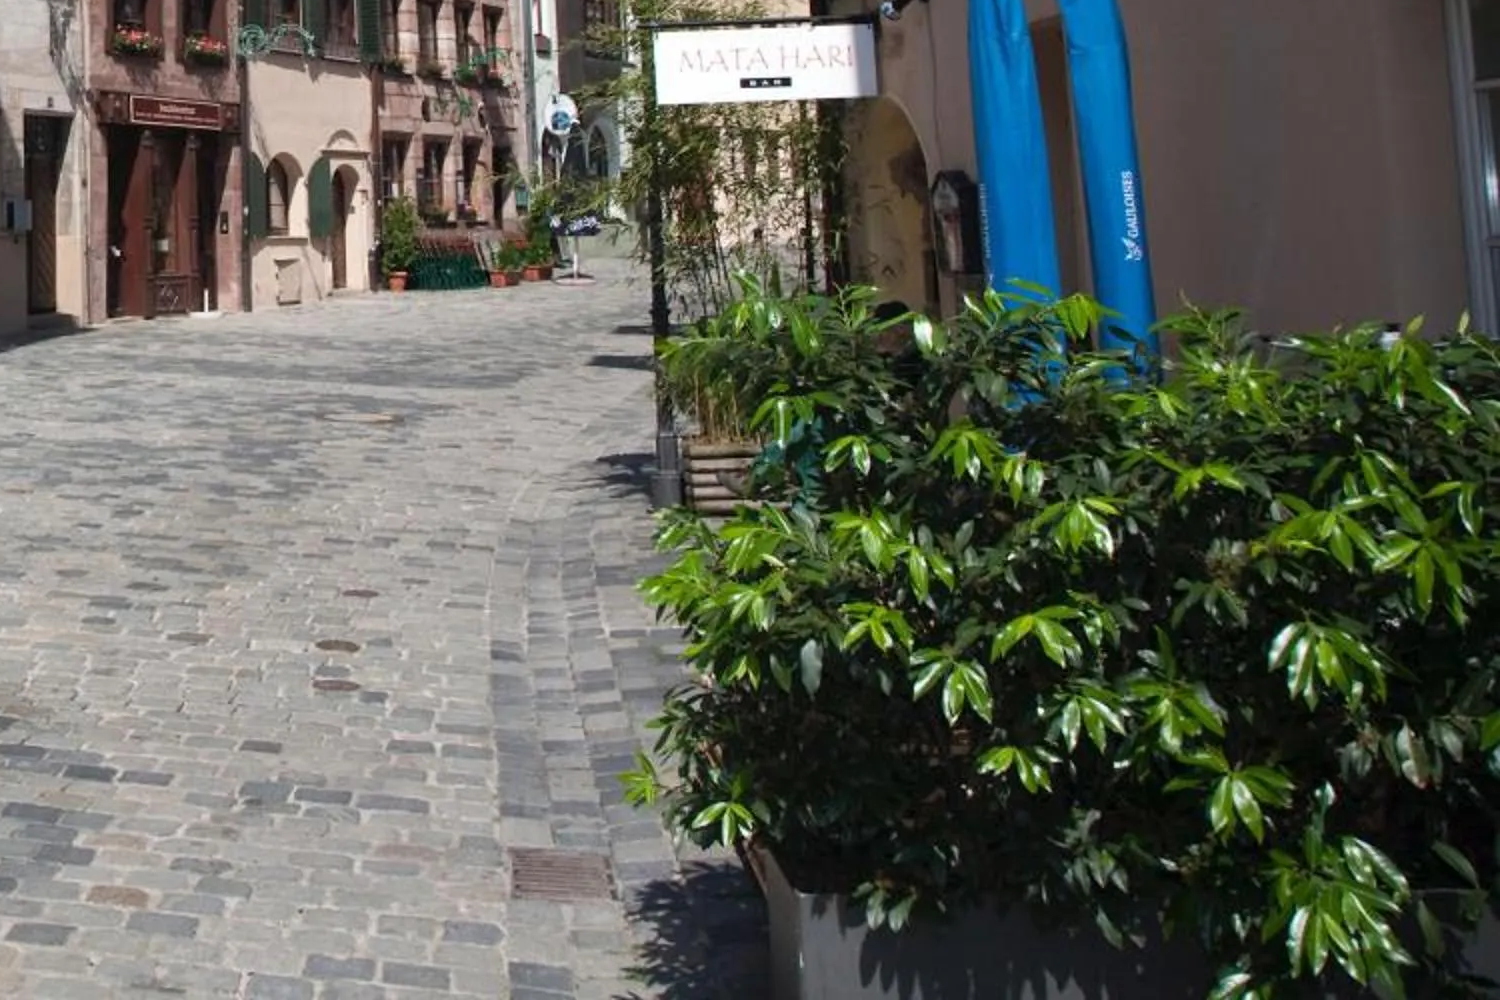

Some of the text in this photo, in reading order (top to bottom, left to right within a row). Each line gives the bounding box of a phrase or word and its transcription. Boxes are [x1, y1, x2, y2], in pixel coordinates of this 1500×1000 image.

[679, 43, 854, 73] MATA HARI
[748, 78, 782, 87] BAR
